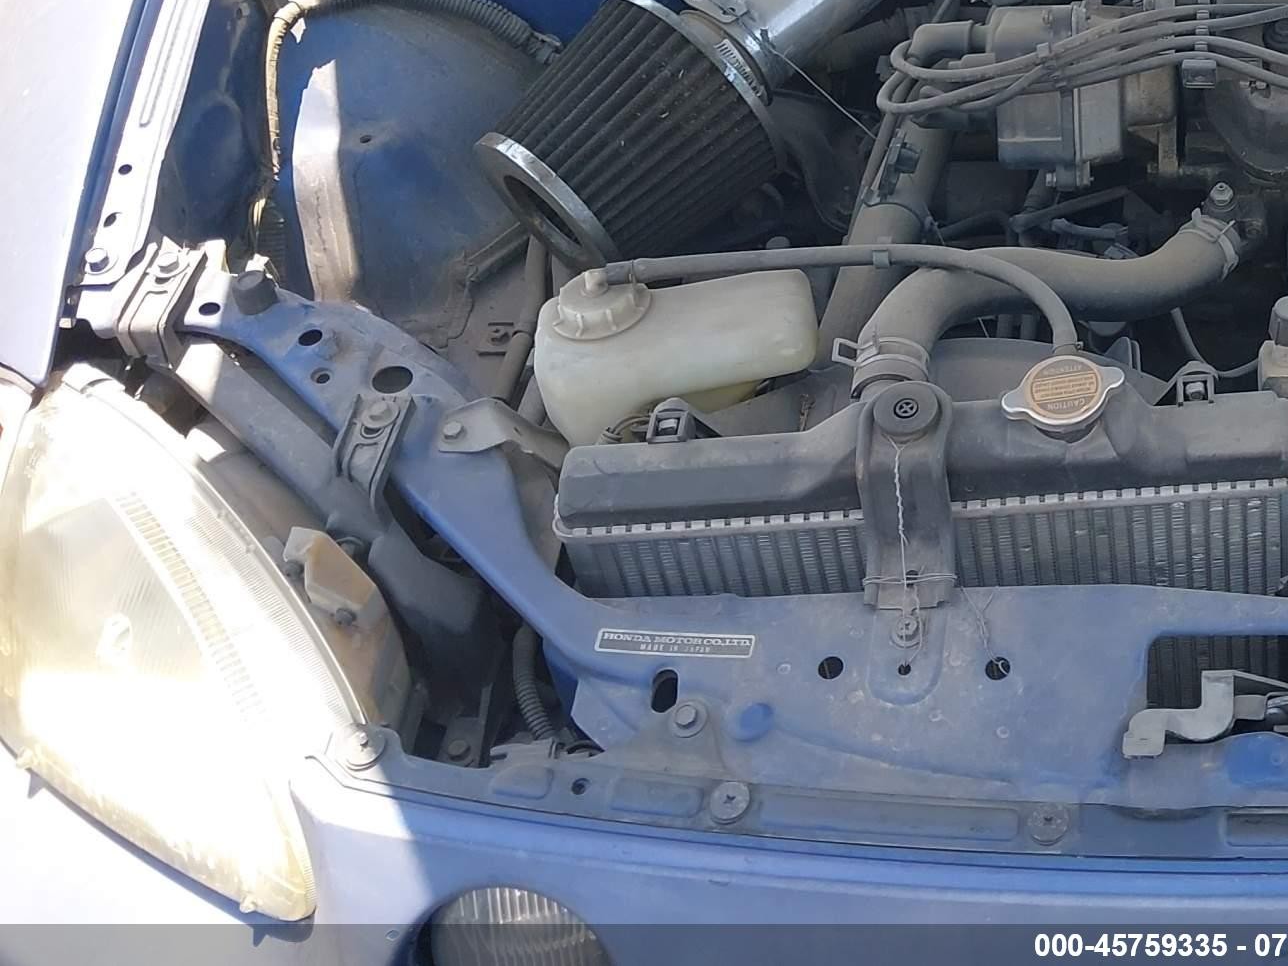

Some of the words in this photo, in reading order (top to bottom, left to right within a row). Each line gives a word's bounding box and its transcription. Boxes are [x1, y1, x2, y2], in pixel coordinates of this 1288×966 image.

[1047, 398, 1085, 411] CAUTION
[603, 633, 652, 643] HONDA
[654, 636, 704, 645] MOTOR
